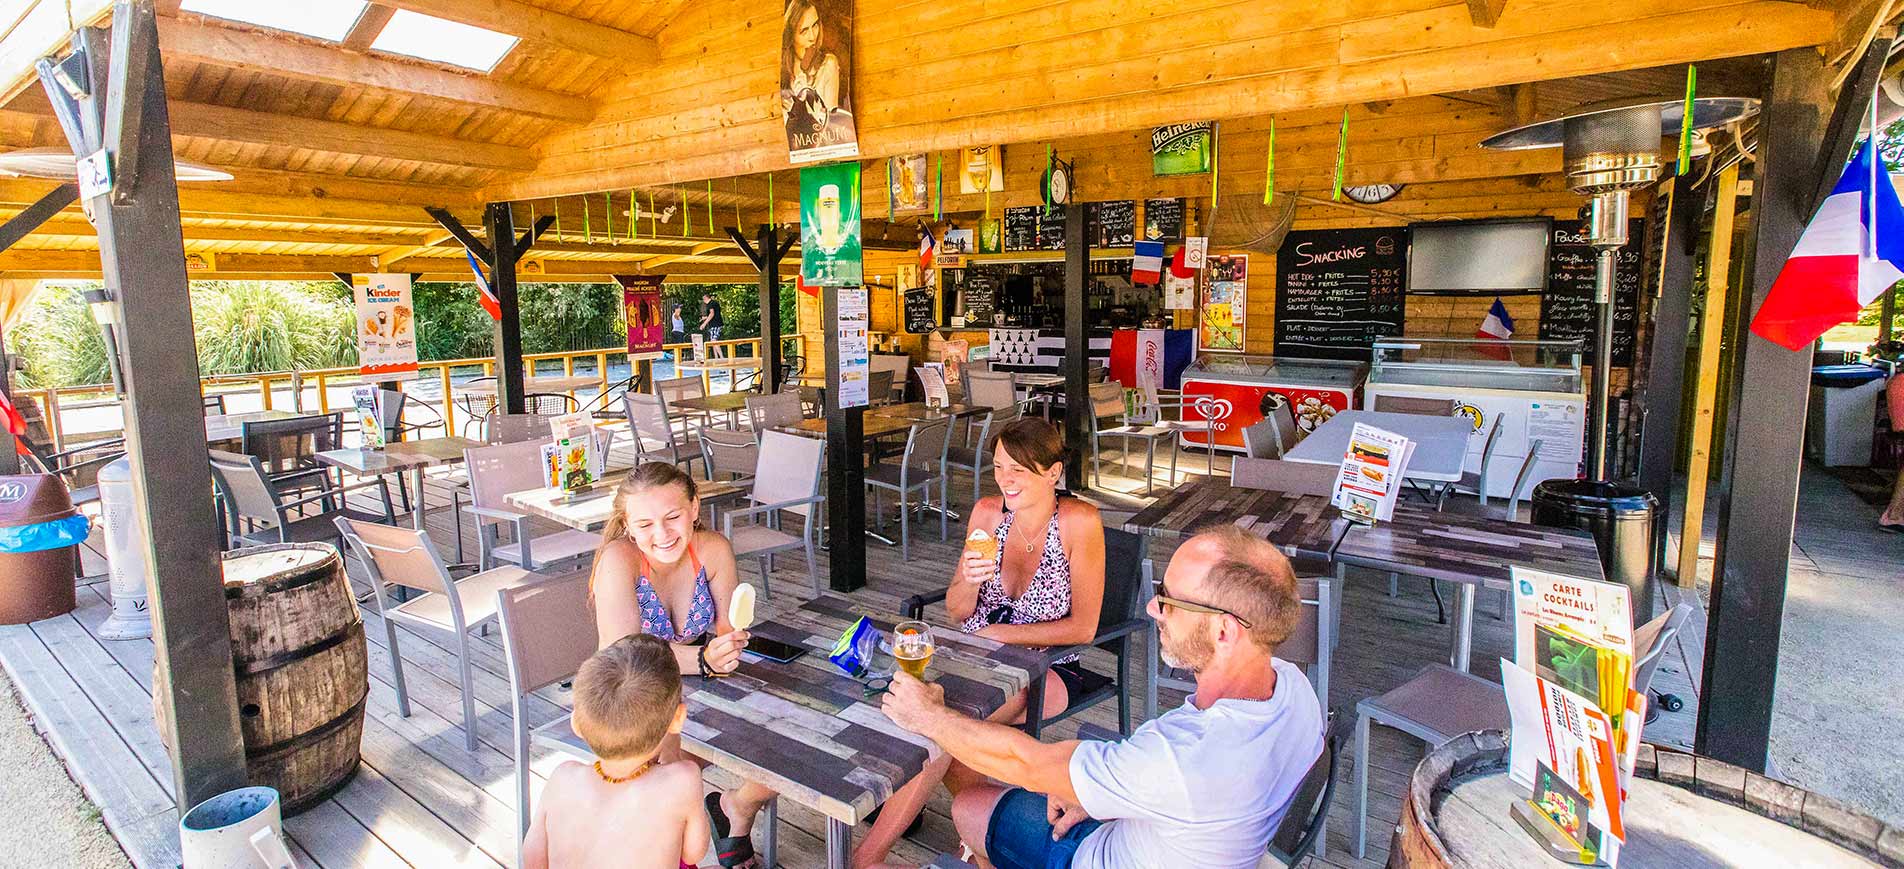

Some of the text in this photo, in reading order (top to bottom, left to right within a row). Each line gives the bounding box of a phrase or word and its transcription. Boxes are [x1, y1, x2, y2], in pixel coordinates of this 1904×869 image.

[793, 127, 850, 148] MAGNUM
[1554, 230, 1586, 243] Pause
[1324, 272, 1345, 280] FRITES
[366, 287, 401, 297] Kinder
[1287, 288, 1322, 296] HAMBURGER
[1552, 583, 1582, 597] CARTE
[1543, 593, 1594, 612] COCKTAILS
[1551, 687, 1563, 727] HOTDOG
